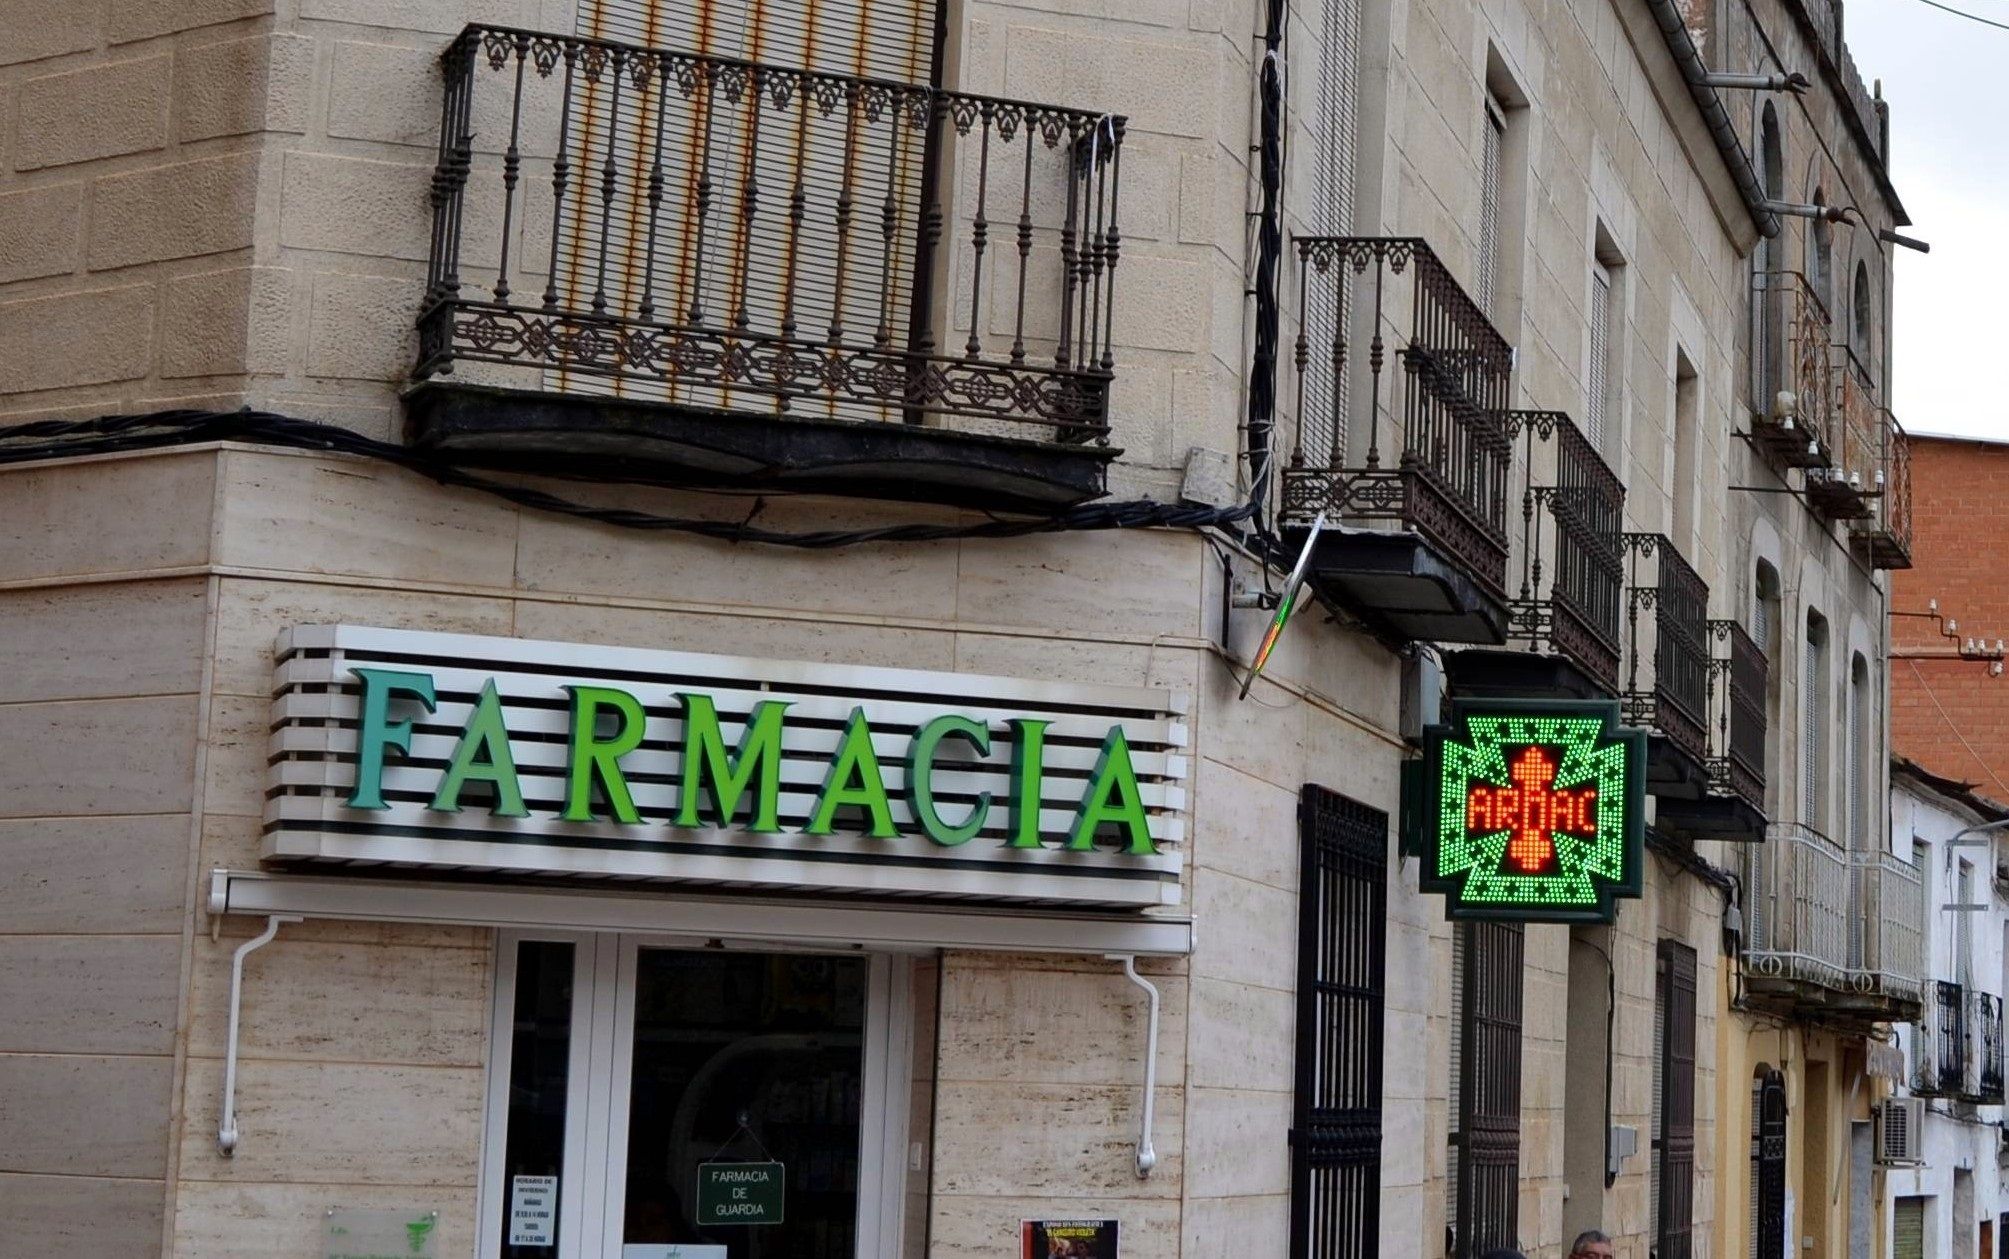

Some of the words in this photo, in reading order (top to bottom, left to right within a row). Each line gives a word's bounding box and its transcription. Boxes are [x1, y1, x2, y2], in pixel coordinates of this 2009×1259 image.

[342, 667, 1164, 855] FARMACIA
[1467, 787, 1596, 832] ARMAC
[711, 1170, 769, 1182] FARMACIA
[732, 1187, 748, 1199] DE
[715, 1203, 764, 1216] GUARDIA
